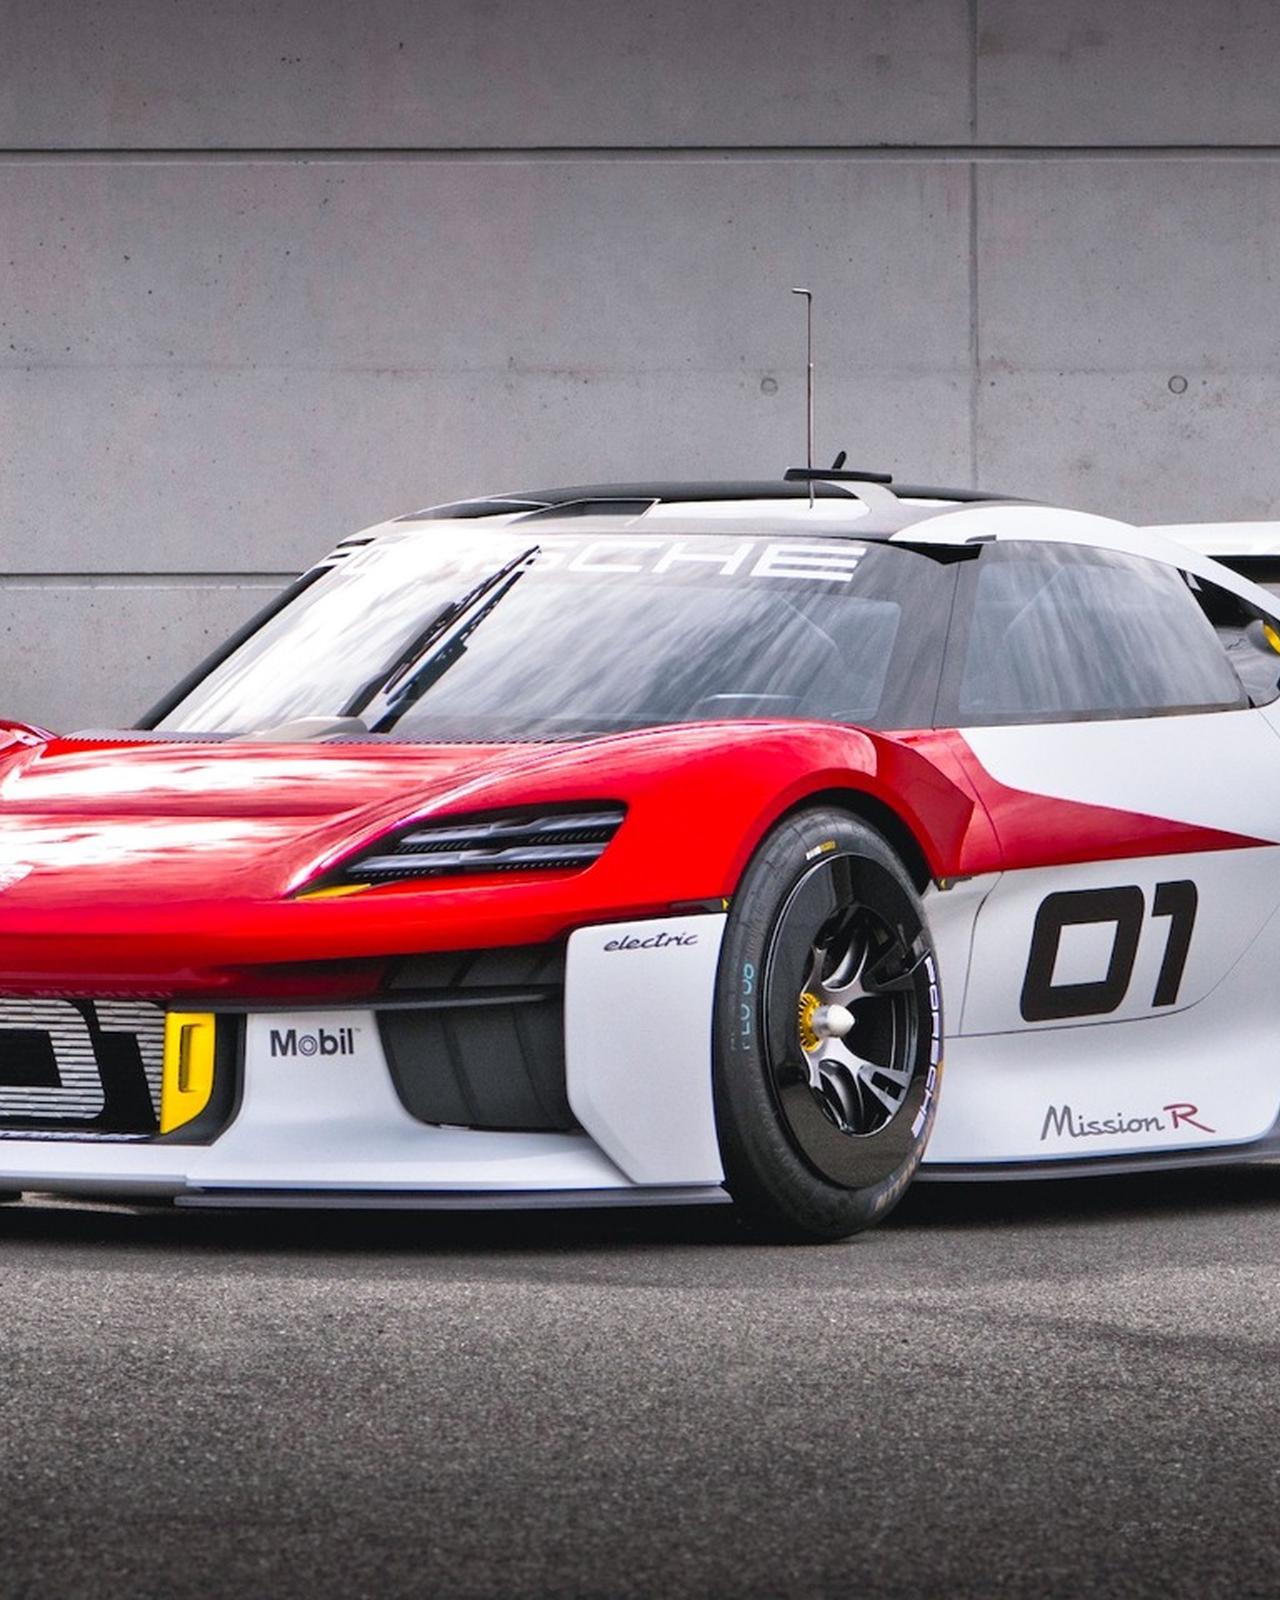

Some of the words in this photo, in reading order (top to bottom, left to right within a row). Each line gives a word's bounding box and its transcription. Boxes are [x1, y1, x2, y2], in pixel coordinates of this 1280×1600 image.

[320, 538, 868, 582] POSCHE
[603, 931, 699, 953] electric
[1020, 879, 1199, 1022] 01
[269, 1027, 355, 1058] Mobil
[911, 955, 941, 1138] PORSCHE
[1040, 1104, 1165, 1141] Mission
[1163, 1103, 1216, 1133] R
